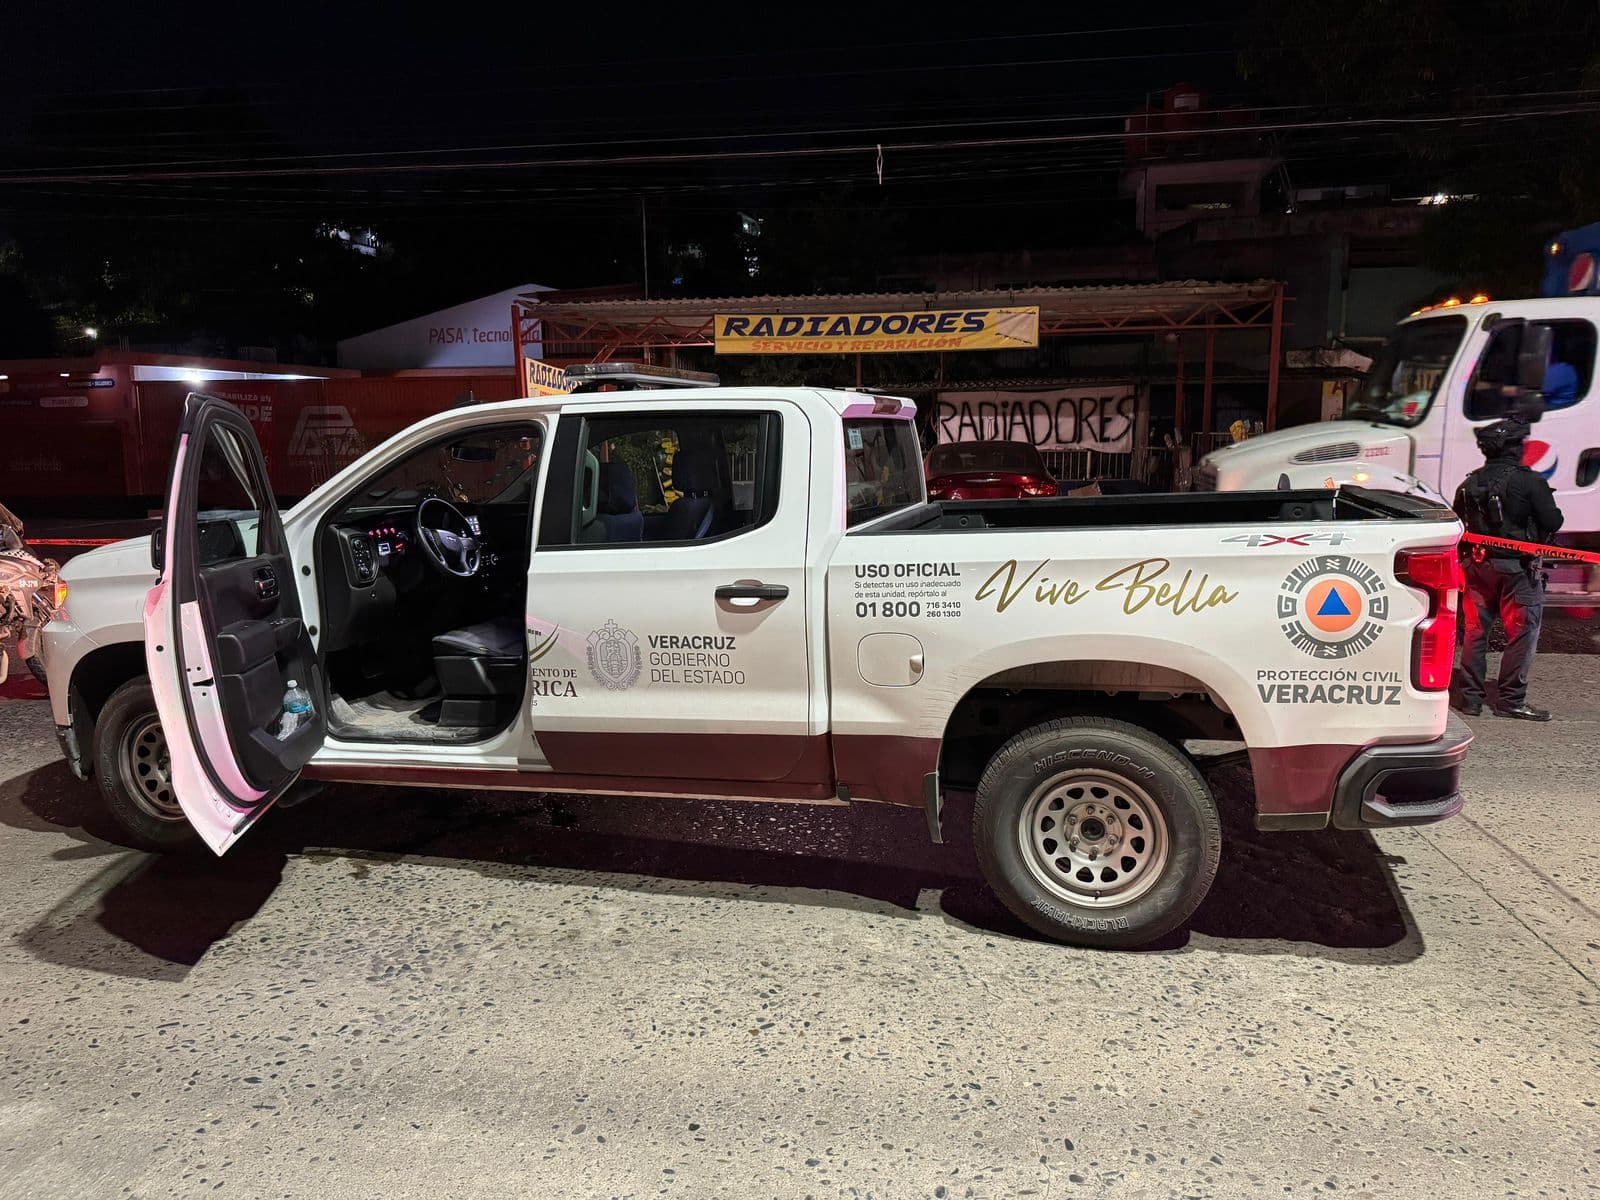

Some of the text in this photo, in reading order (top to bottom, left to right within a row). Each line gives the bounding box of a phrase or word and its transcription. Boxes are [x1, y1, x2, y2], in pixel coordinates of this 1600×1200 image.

[722, 311, 990, 337] RADIADORES
[751, 336, 961, 351] SERVICIO Y REPARACIÓN
[855, 562, 961, 578] USO OFICIAL
[854, 581, 862, 589] Si
[862, 581, 894, 589] detectas
[920, 579, 961, 588] inadecuado
[974, 557, 1239, 616] Vive Bella
[881, 590, 907, 599] unidad,
[908, 590, 940, 600] repórtalo
[856, 601, 921, 618] 01 800
[941, 601, 961, 609] 3410
[942, 610, 961, 618] 1300
[648, 635, 736, 650] VERACRUZ
[649, 652, 730, 668] GOBIERNO
[562, 669, 578, 679] DE
[650, 669, 745, 685] DEL ESTADO
[1257, 668, 1403, 683] PROTECCIÓN CIVIL
[532, 680, 579, 698] RICA
[1257, 684, 1401, 706] VERACRUZ
